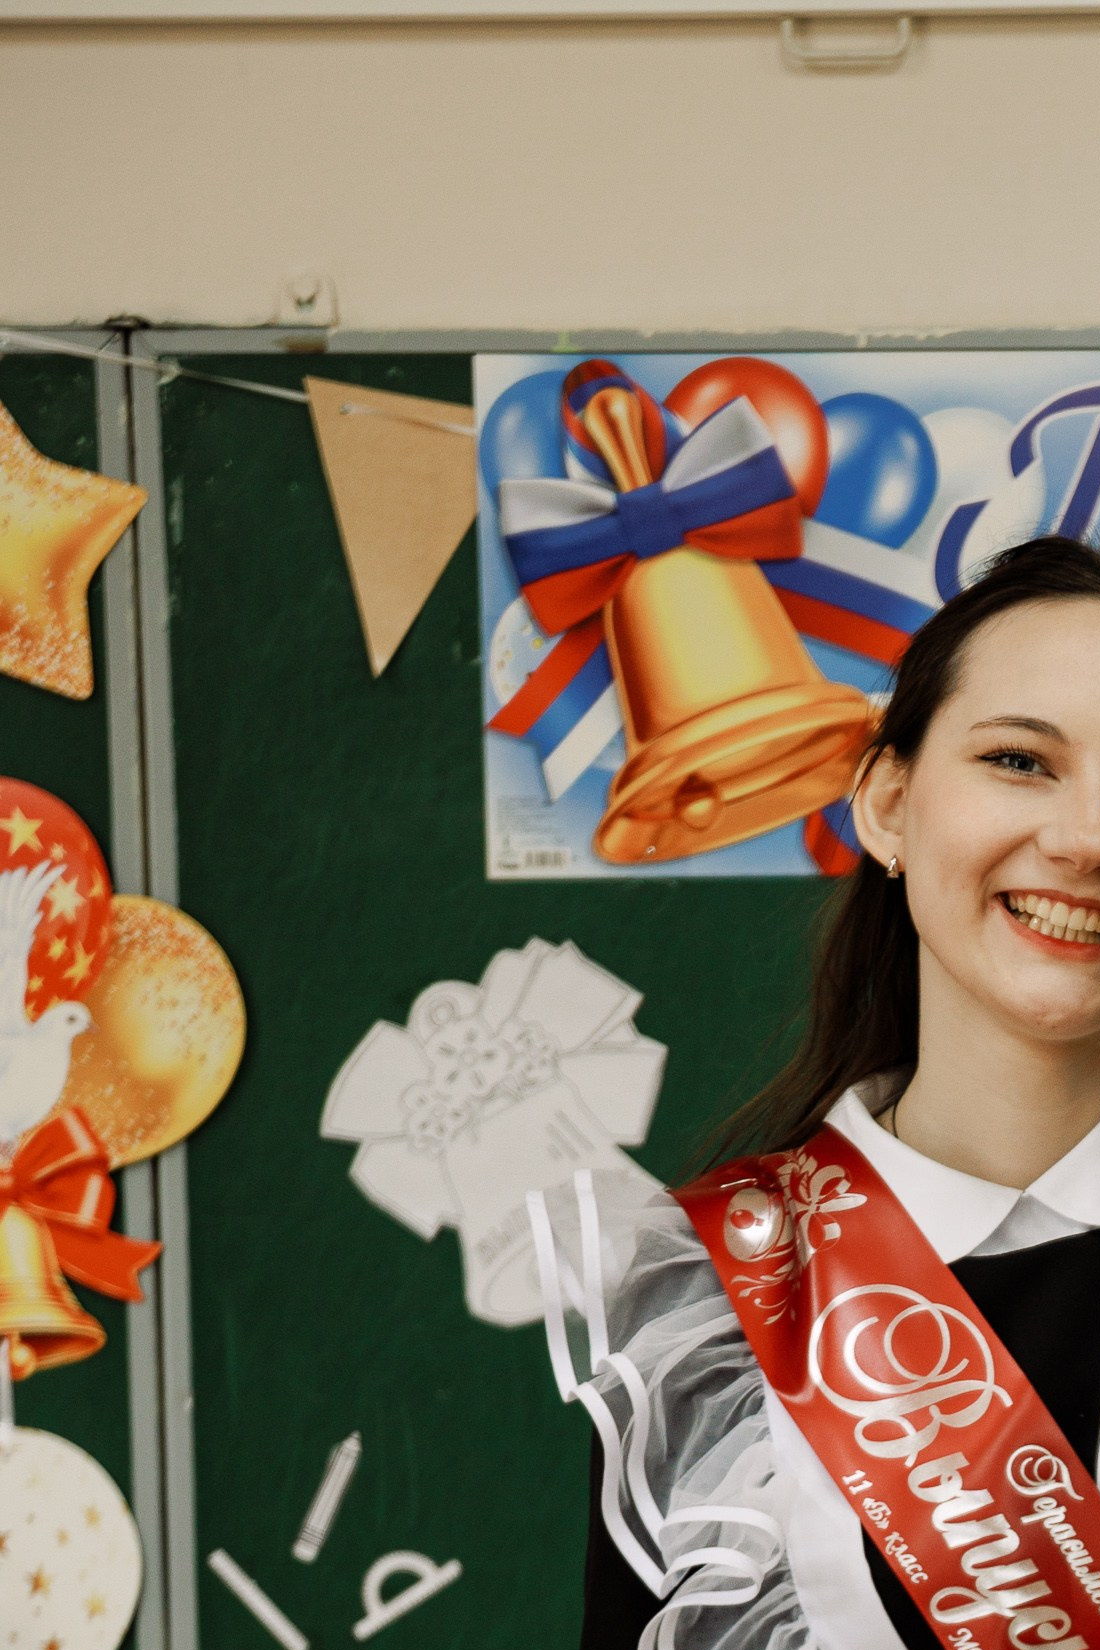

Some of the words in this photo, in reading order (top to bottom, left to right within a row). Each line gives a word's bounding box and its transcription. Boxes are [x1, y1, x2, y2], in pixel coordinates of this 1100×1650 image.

[841, 1468, 874, 1496] 11
[861, 1496, 891, 1531] «Б»
[884, 1530, 929, 1584] класс
